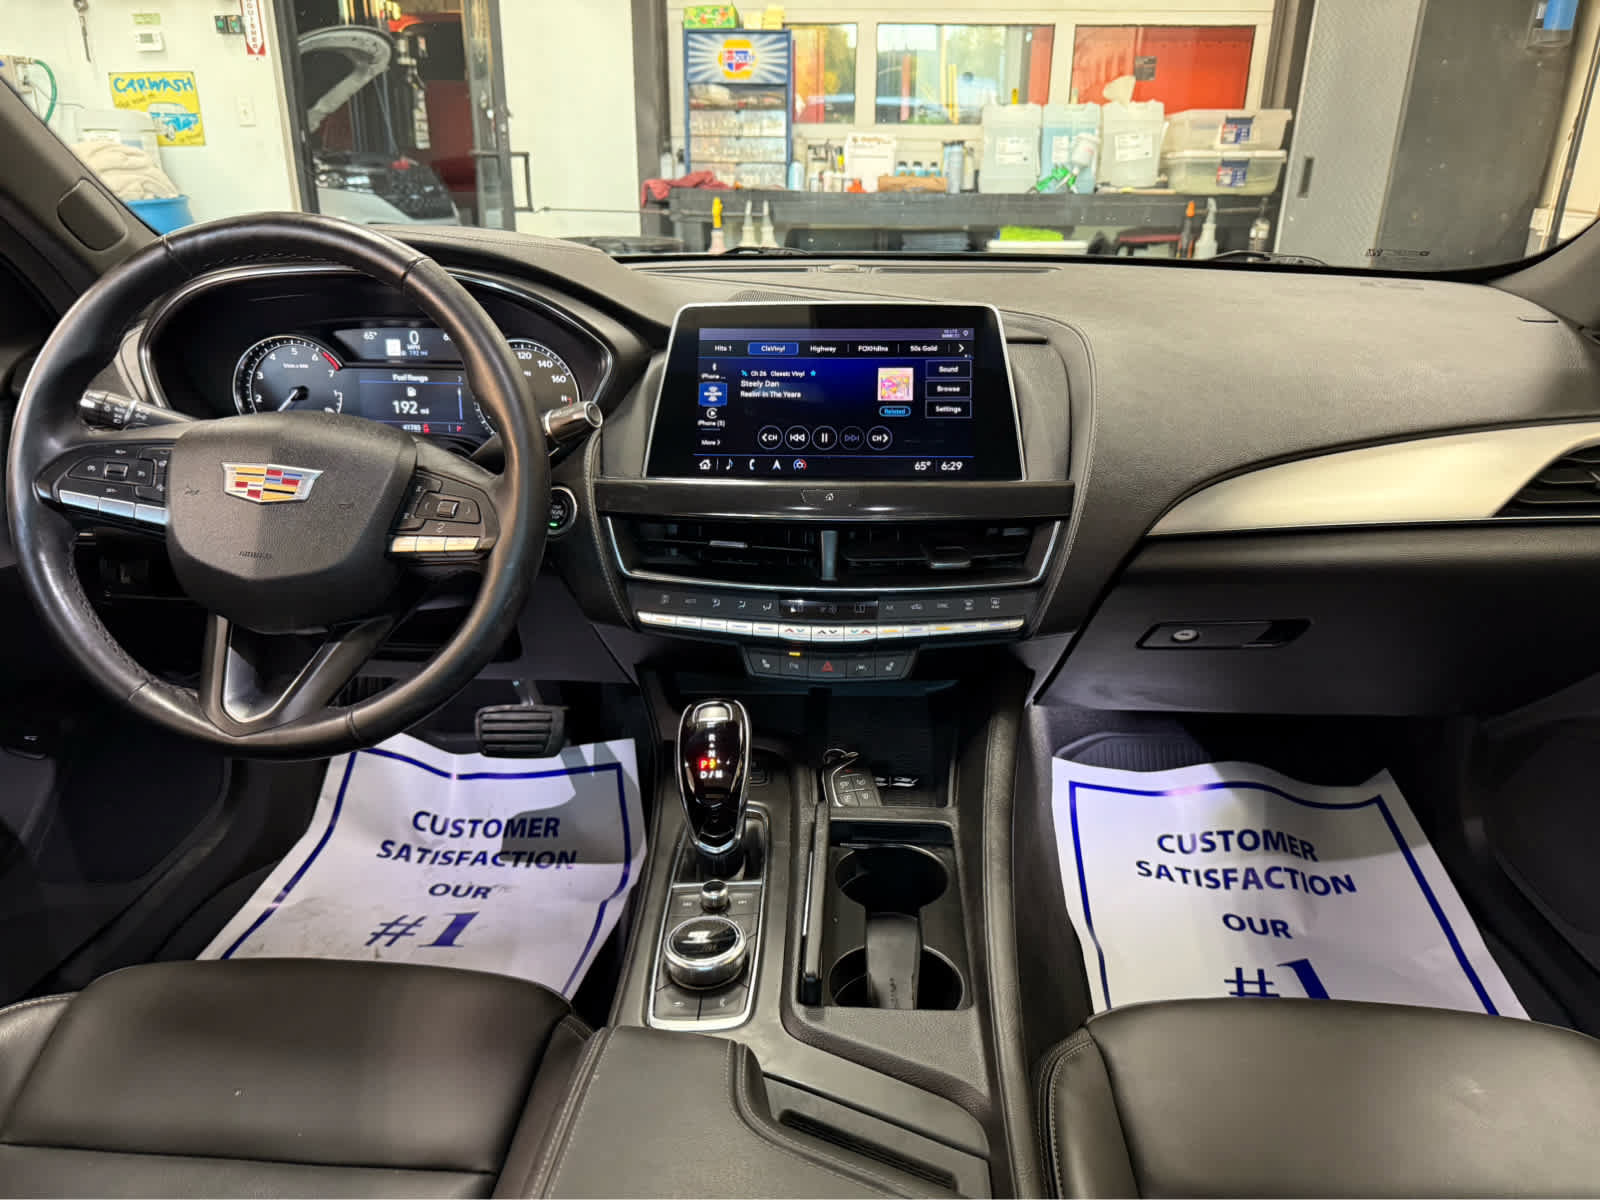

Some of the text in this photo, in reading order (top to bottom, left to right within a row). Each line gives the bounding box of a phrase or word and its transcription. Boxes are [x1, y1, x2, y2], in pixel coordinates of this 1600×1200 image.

[409, 330, 419, 344] 0
[291, 347, 298, 355] 5
[810, 345, 837, 354] Highway
[269, 353, 277, 361] 4
[311, 353, 319, 362] 6
[517, 351, 532, 360] 120
[537, 360, 553, 369] 140
[256, 371, 264, 380] 3
[328, 369, 336, 378] 7
[792, 370, 805, 378] Vinyl
[551, 375, 567, 384] 160
[740, 380, 780, 388] Steely Dan
[937, 385, 960, 393] Browse
[255, 394, 263, 403] 2
[769, 391, 782, 399] The
[782, 391, 802, 399] Years
[392, 400, 418, 414] 192
[935, 405, 962, 414] Settings
[914, 461, 931, 471] 65°
[941, 461, 963, 471] 6:29
[708, 733, 716, 742] R
[708, 750, 716, 758] N
[700, 760, 708, 769] P
[412, 810, 561, 839] CUSTOMER
[1157, 829, 1319, 862] CUSTOMER
[376, 839, 578, 870] SATISFACTION
[1135, 860, 1357, 896] SATISFACTION
[428, 883, 492, 900] OUR
[364, 911, 480, 948] #1
[1222, 913, 1293, 939] OUR
